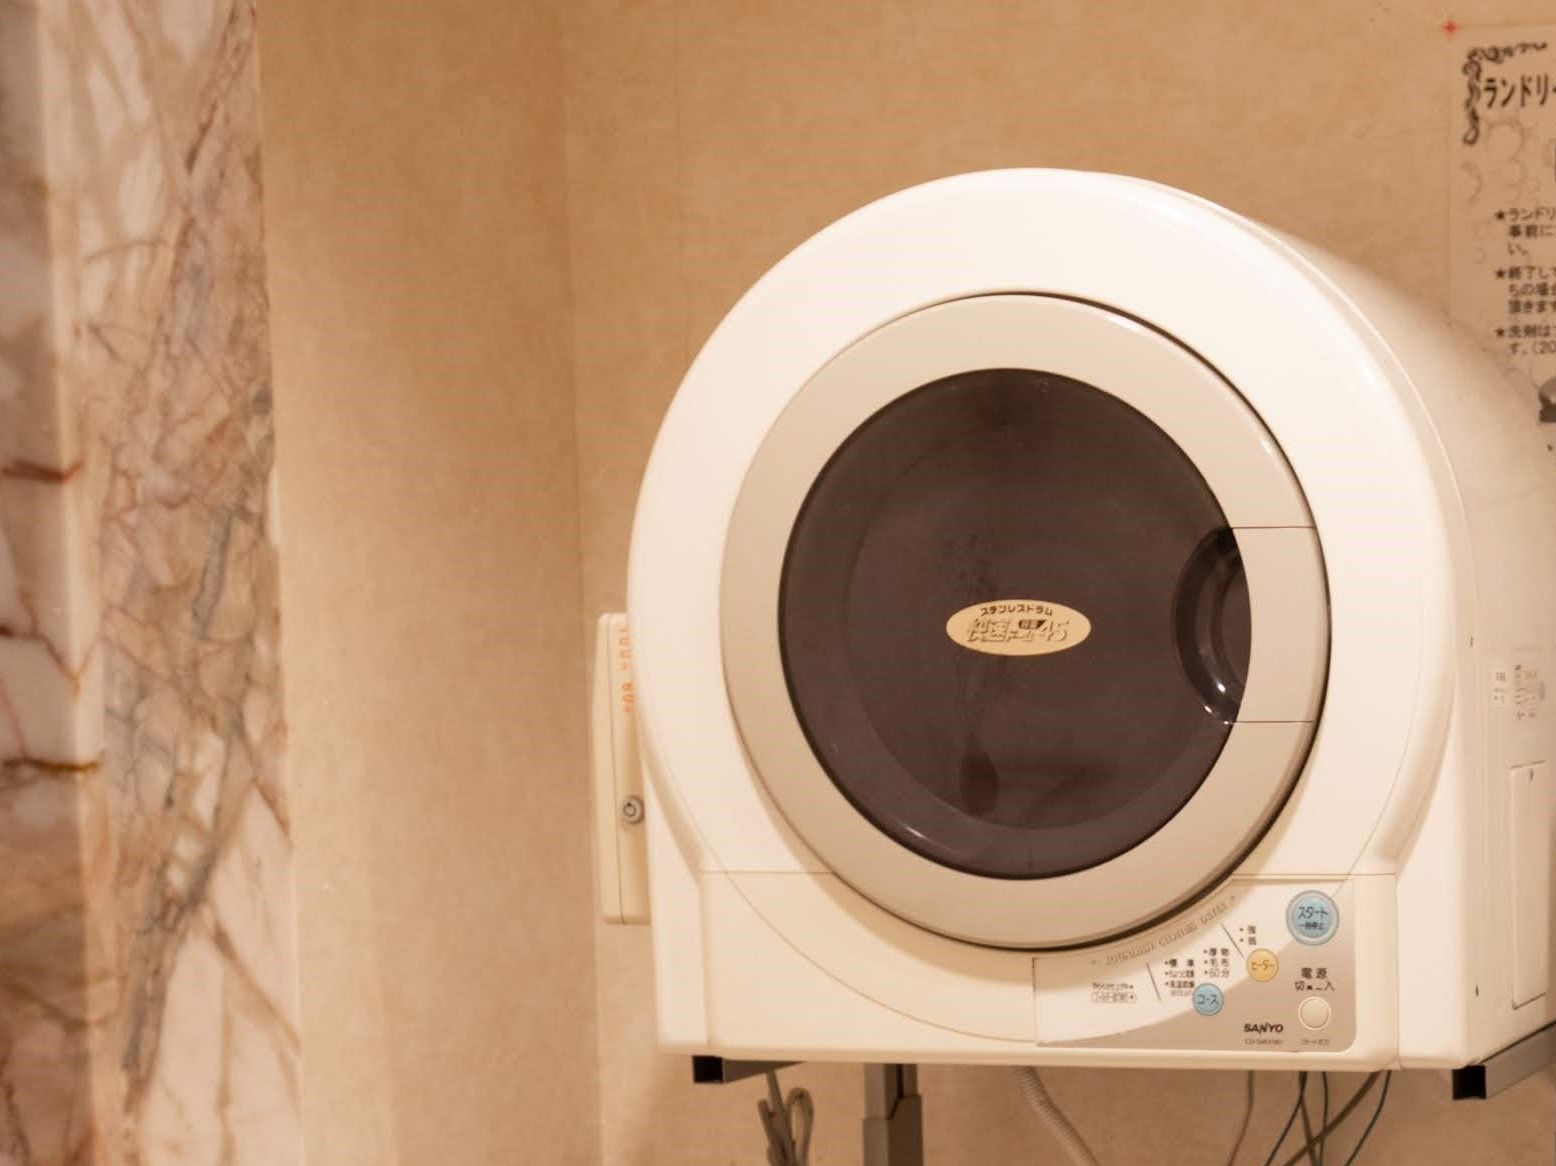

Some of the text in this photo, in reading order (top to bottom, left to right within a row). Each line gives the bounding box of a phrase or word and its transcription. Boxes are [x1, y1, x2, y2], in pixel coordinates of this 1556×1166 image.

[1297, 905, 1329, 921] スタート
[1251, 960, 1276, 970] ヒーター
[1197, 994, 1218, 1005] コース
[1243, 1022, 1284, 1034] SANYO
